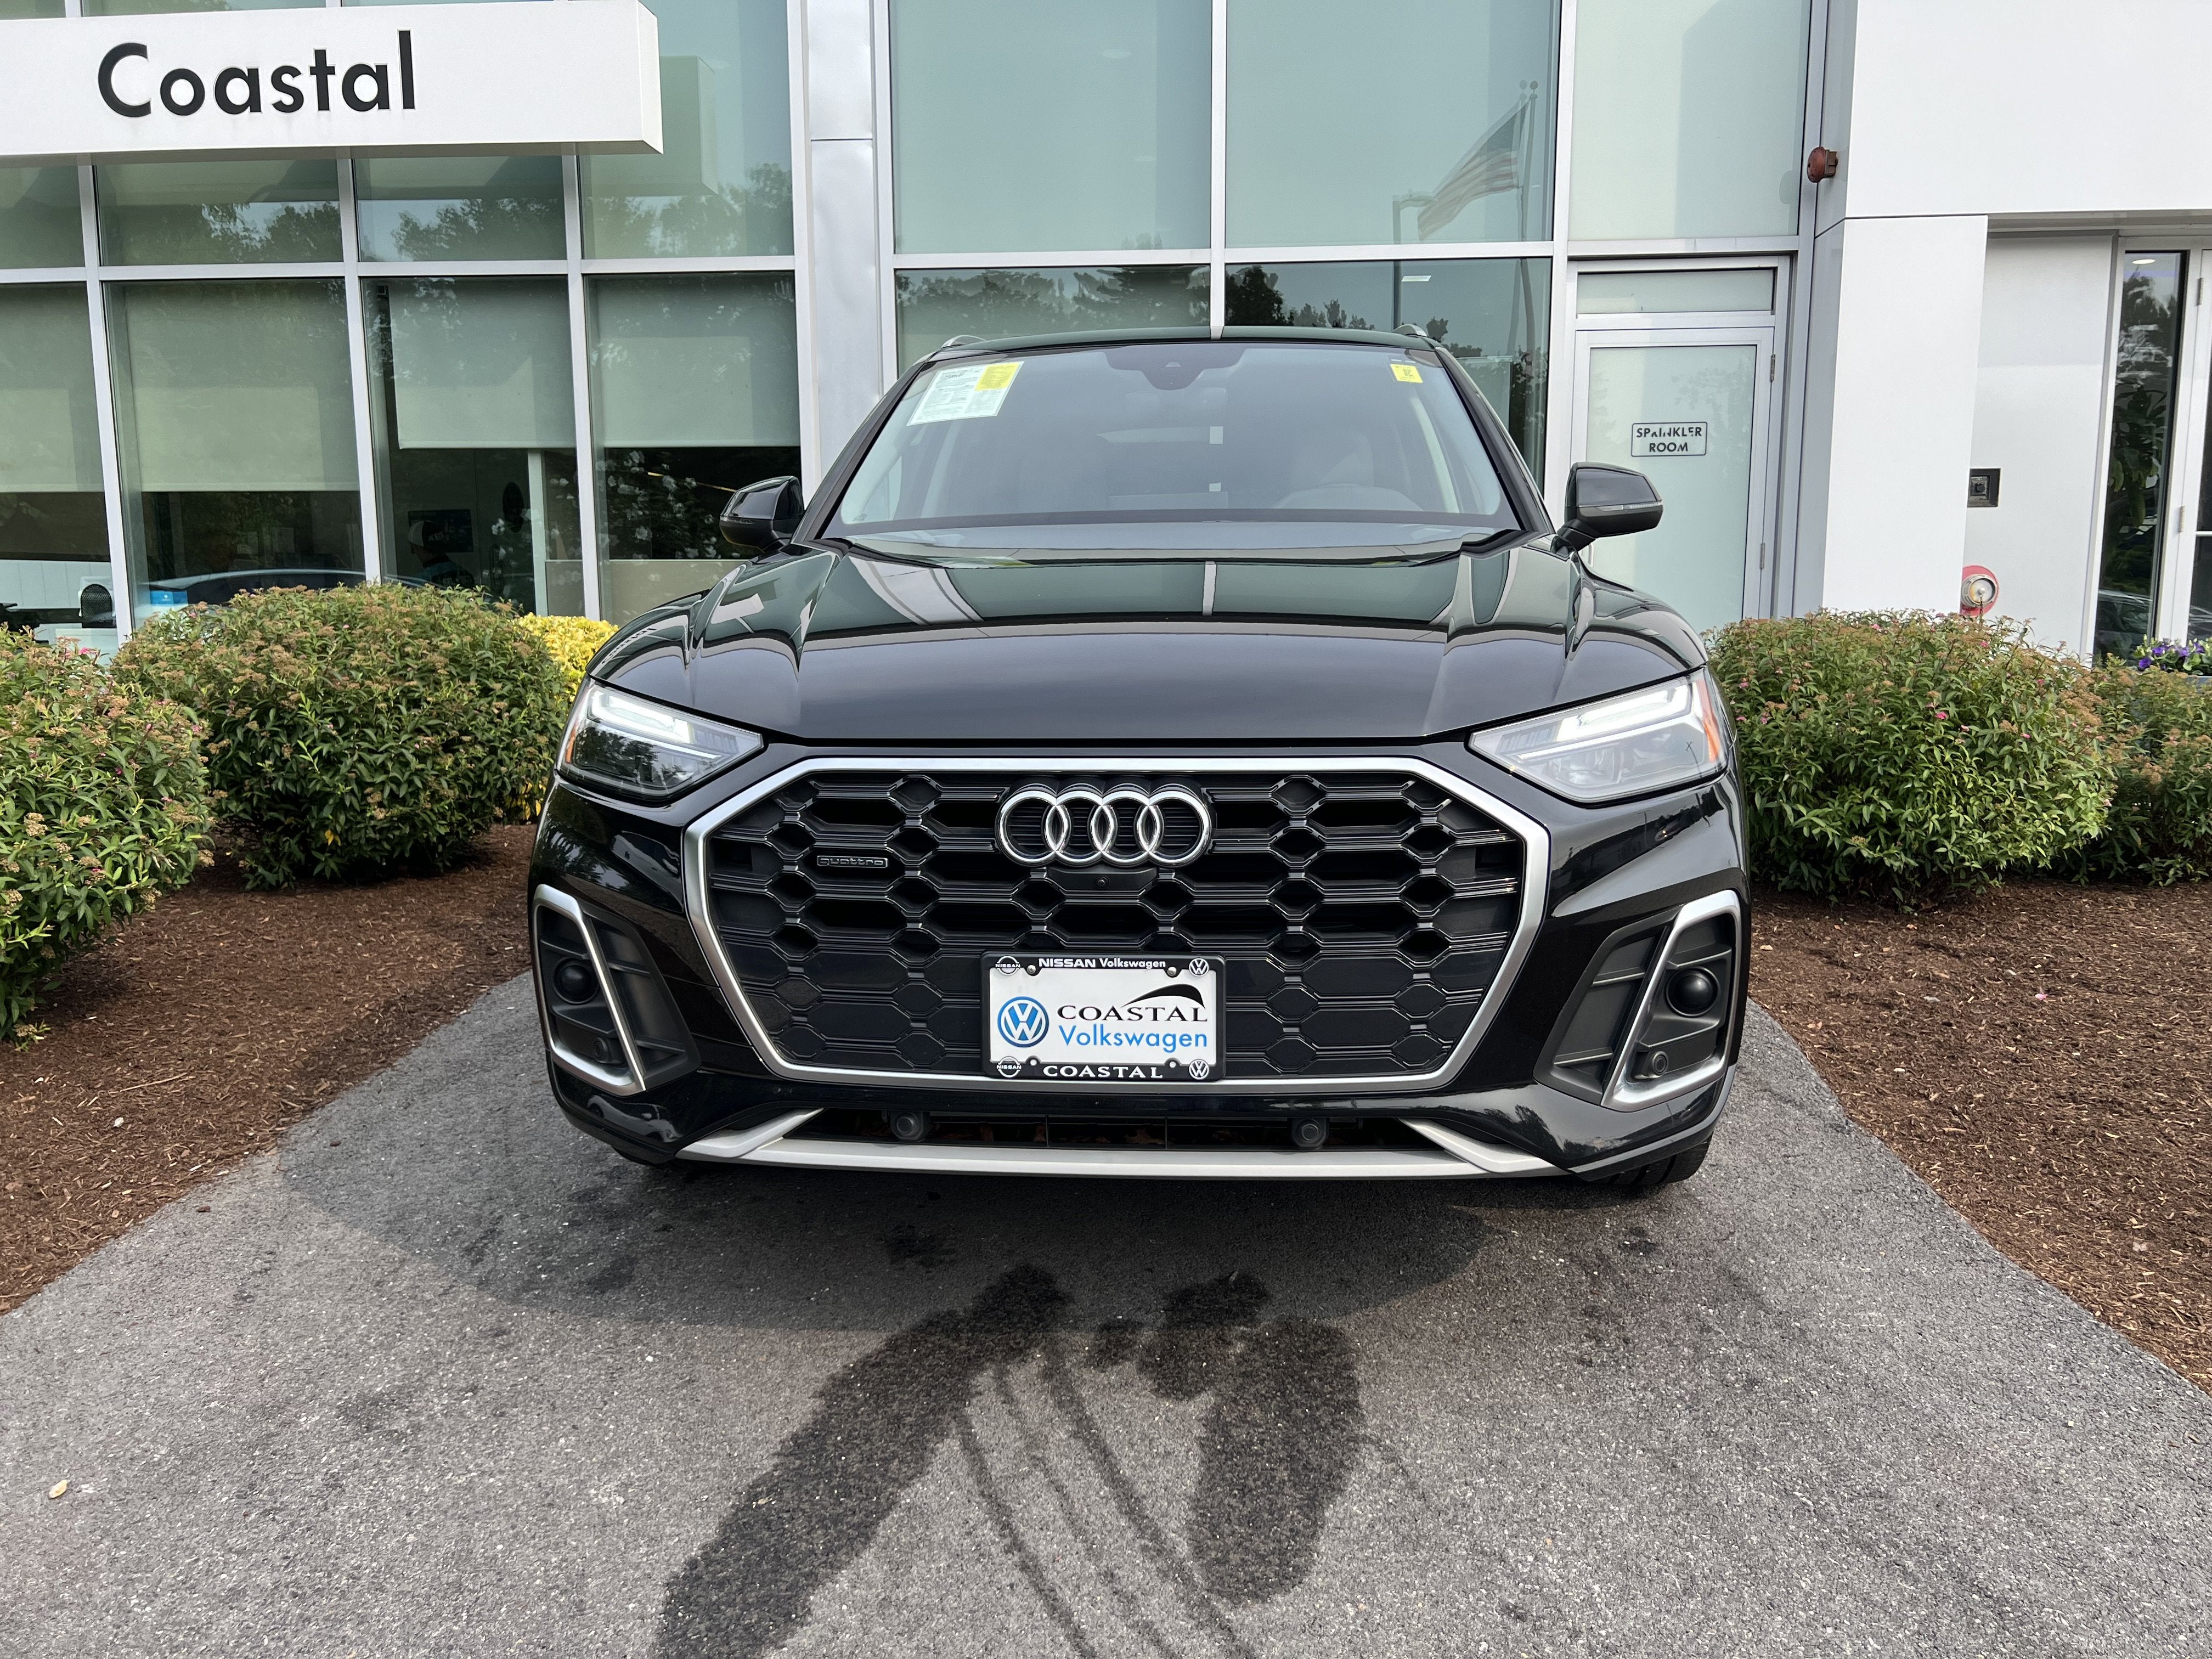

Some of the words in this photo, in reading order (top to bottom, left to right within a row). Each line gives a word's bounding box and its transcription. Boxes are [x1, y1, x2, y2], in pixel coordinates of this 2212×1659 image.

[98, 30, 416, 117] Coastal
[1649, 442, 1688, 452] ROOM
[1039, 958, 1096, 968] NISSAN
[1099, 958, 1166, 969] Volkswagen
[1057, 1005, 1207, 1022] COASTAL
[1059, 1024, 1206, 1053] Volkswagen
[1043, 1066, 1162, 1079] COASTAL
